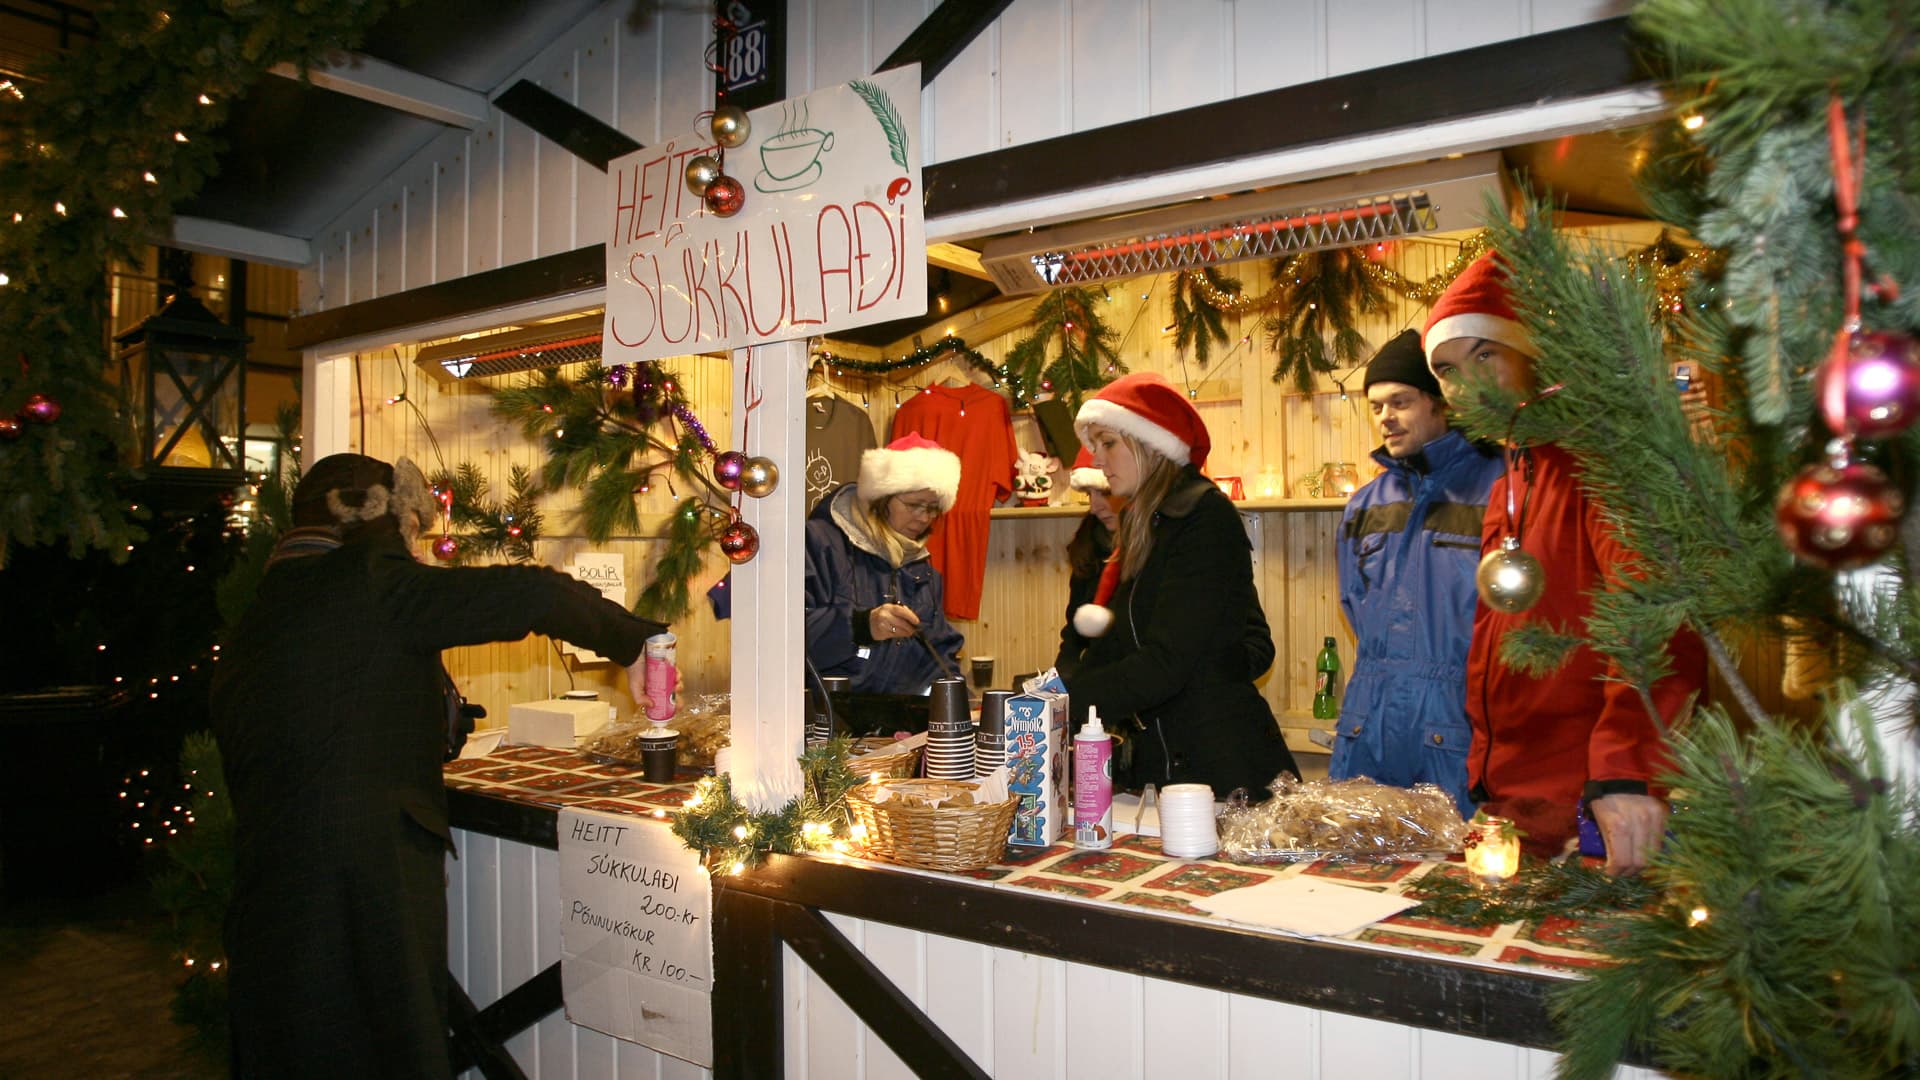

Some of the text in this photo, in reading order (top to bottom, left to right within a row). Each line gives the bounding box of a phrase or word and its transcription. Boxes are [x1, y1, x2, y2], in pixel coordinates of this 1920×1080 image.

[729, 30, 761, 82] 88
[1016, 734, 1035, 750] 1,5
[571, 819, 629, 846] HEITT
[586, 853, 680, 893] SÚKKULAÐI
[632, 949, 652, 972] KR
